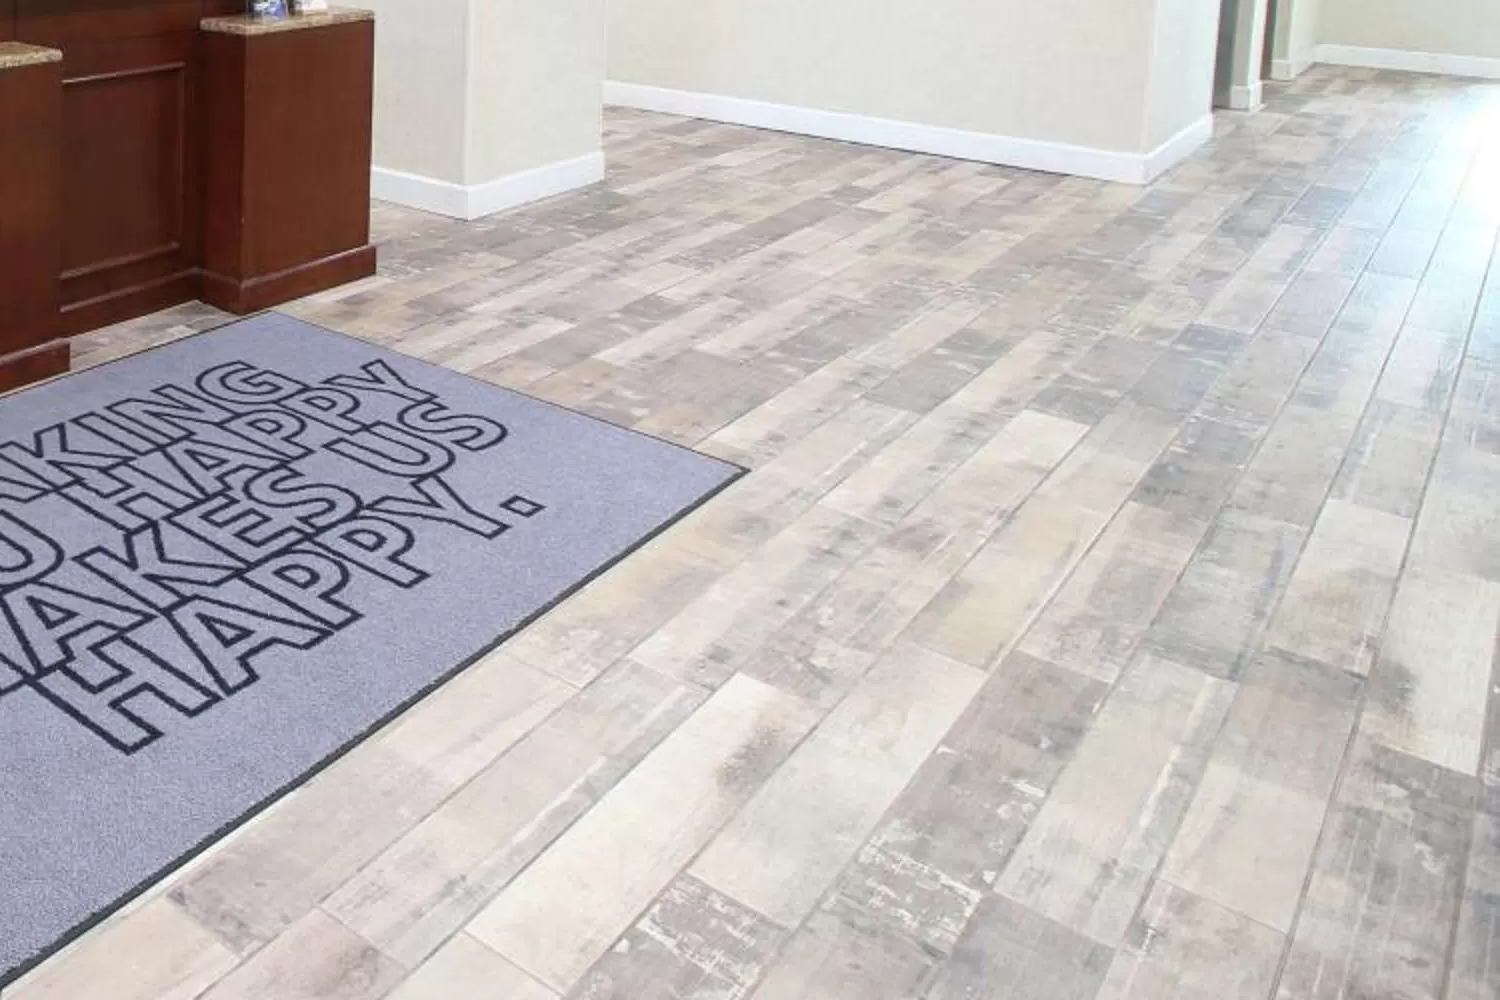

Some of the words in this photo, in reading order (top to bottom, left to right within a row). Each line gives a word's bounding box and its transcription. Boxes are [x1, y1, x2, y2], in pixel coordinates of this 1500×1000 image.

[59, 359, 438, 533] HAPPY
[322, 402, 507, 479] US
[27, 474, 546, 754] HAPPY.
